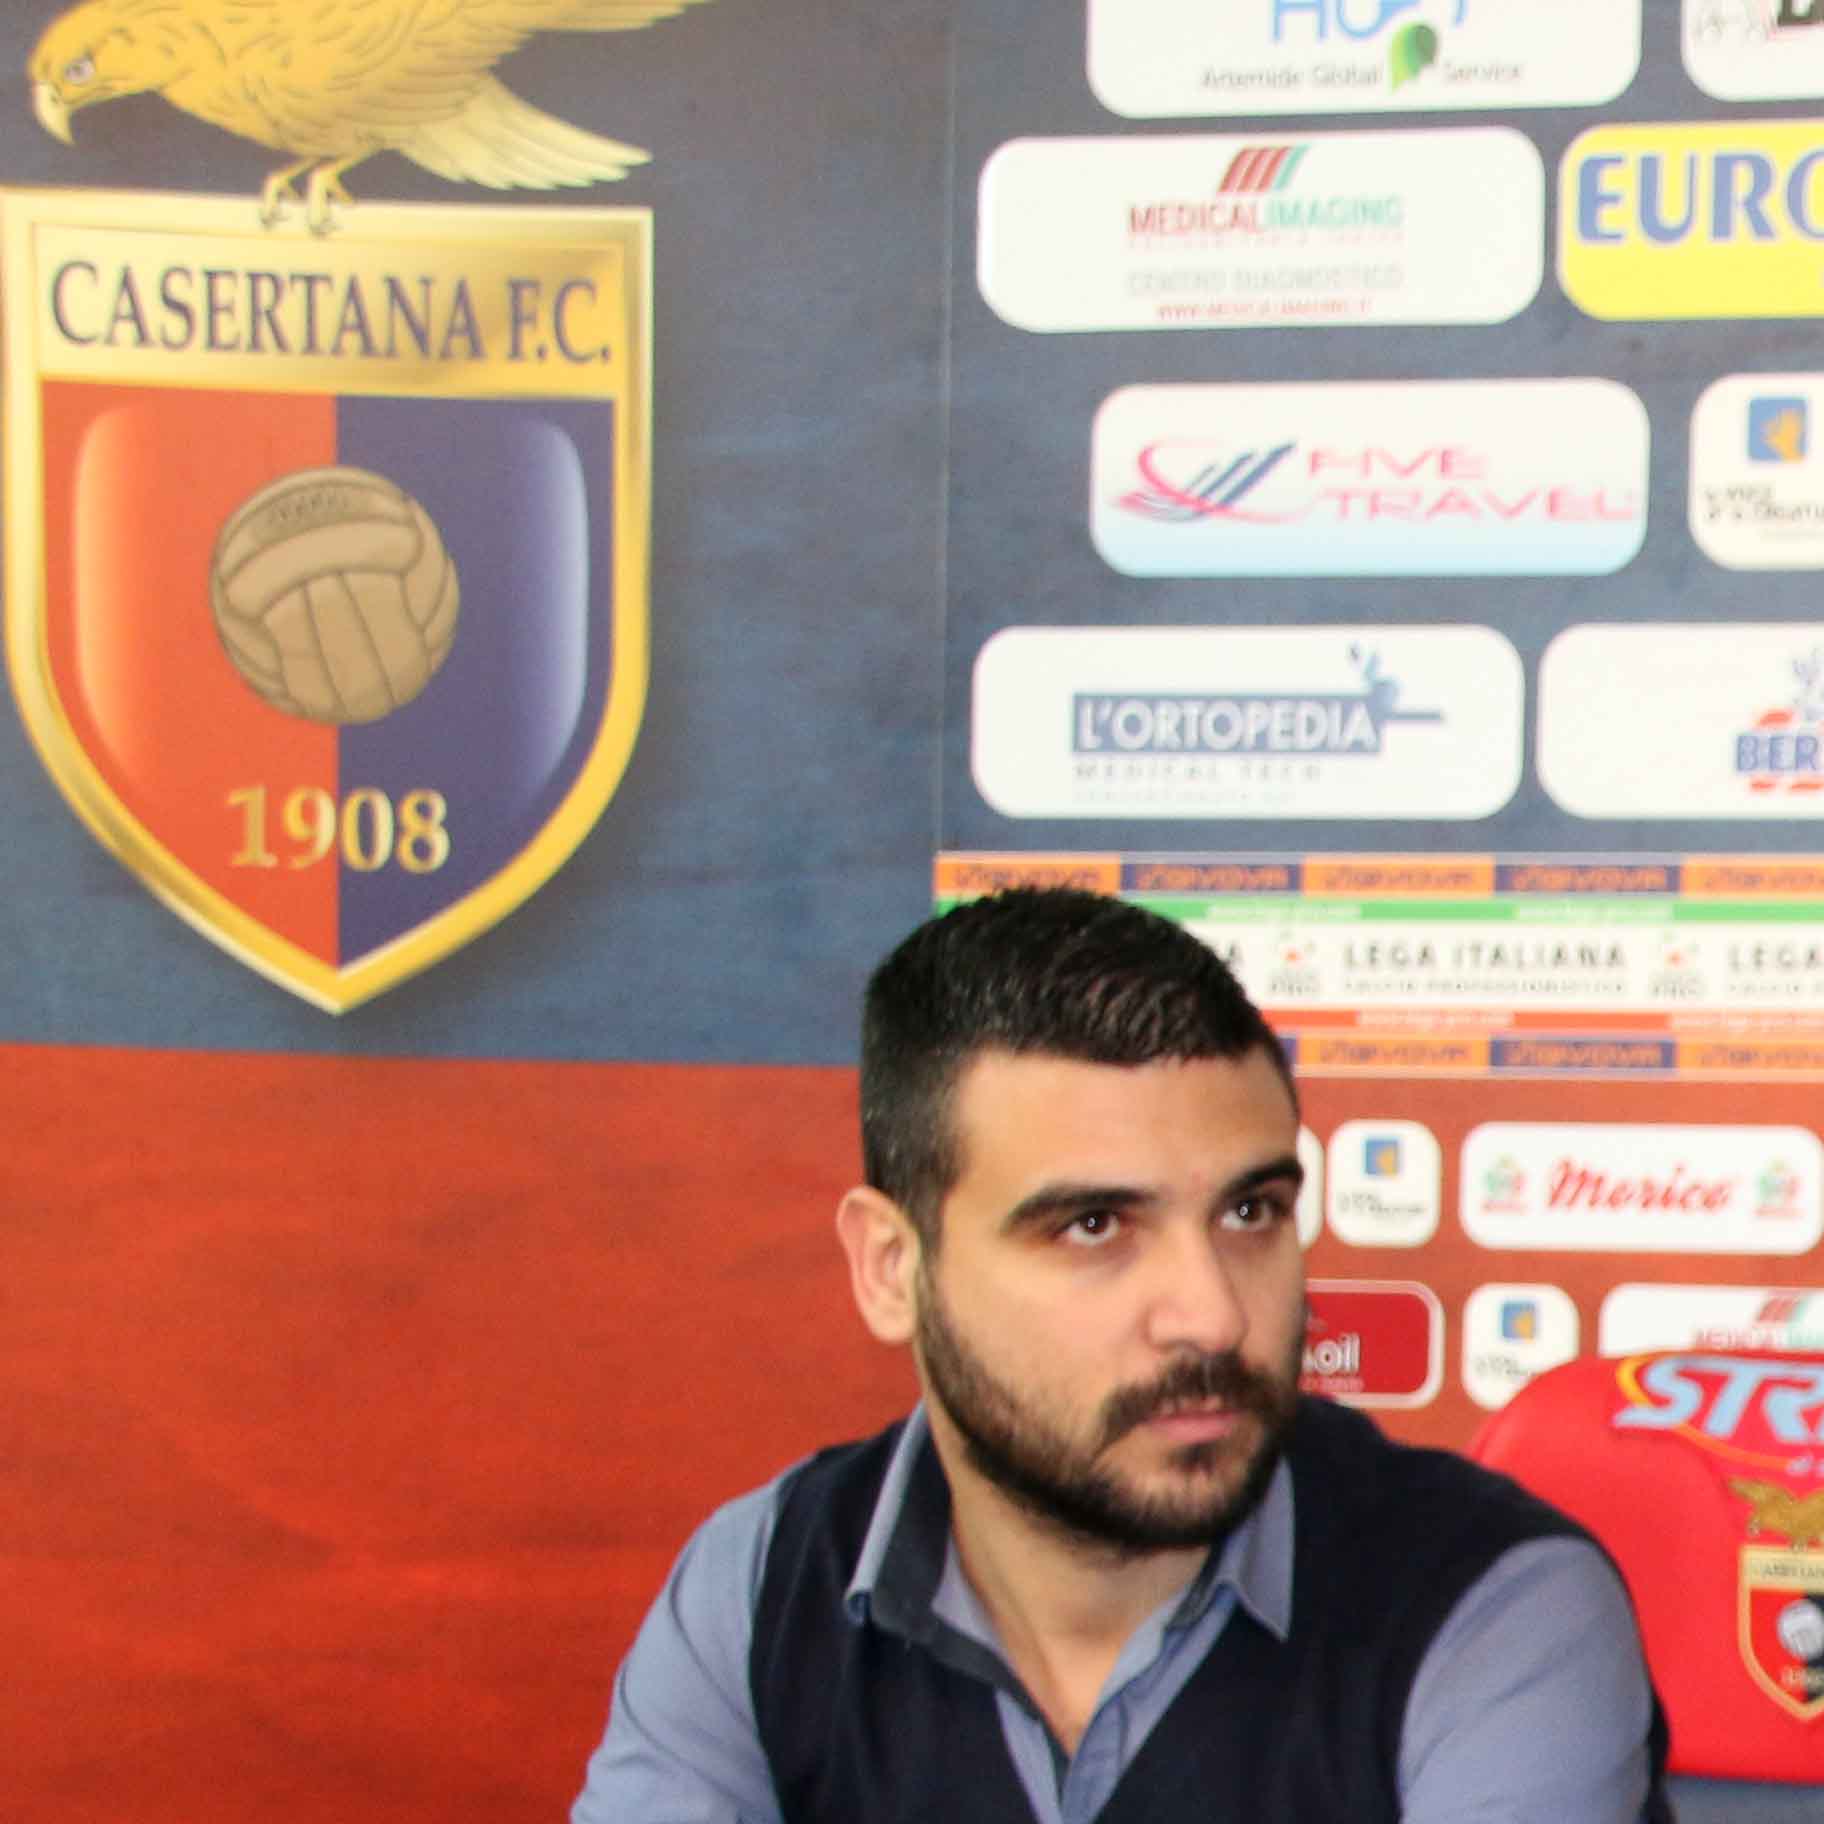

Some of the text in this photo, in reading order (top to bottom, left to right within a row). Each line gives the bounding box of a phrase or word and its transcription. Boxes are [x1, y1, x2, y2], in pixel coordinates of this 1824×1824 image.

[50, 259, 613, 365] CASERTANA F.C.
[1307, 446, 1487, 481] FIVE
[1320, 484, 1636, 522] TRAVEL
[1077, 700, 1380, 751] L'ORTOPEDIA
[226, 785, 451, 875] 1908
[1346, 942, 1628, 969] LEGA ITALIANA
[1727, 945, 1824, 972] LEGA
